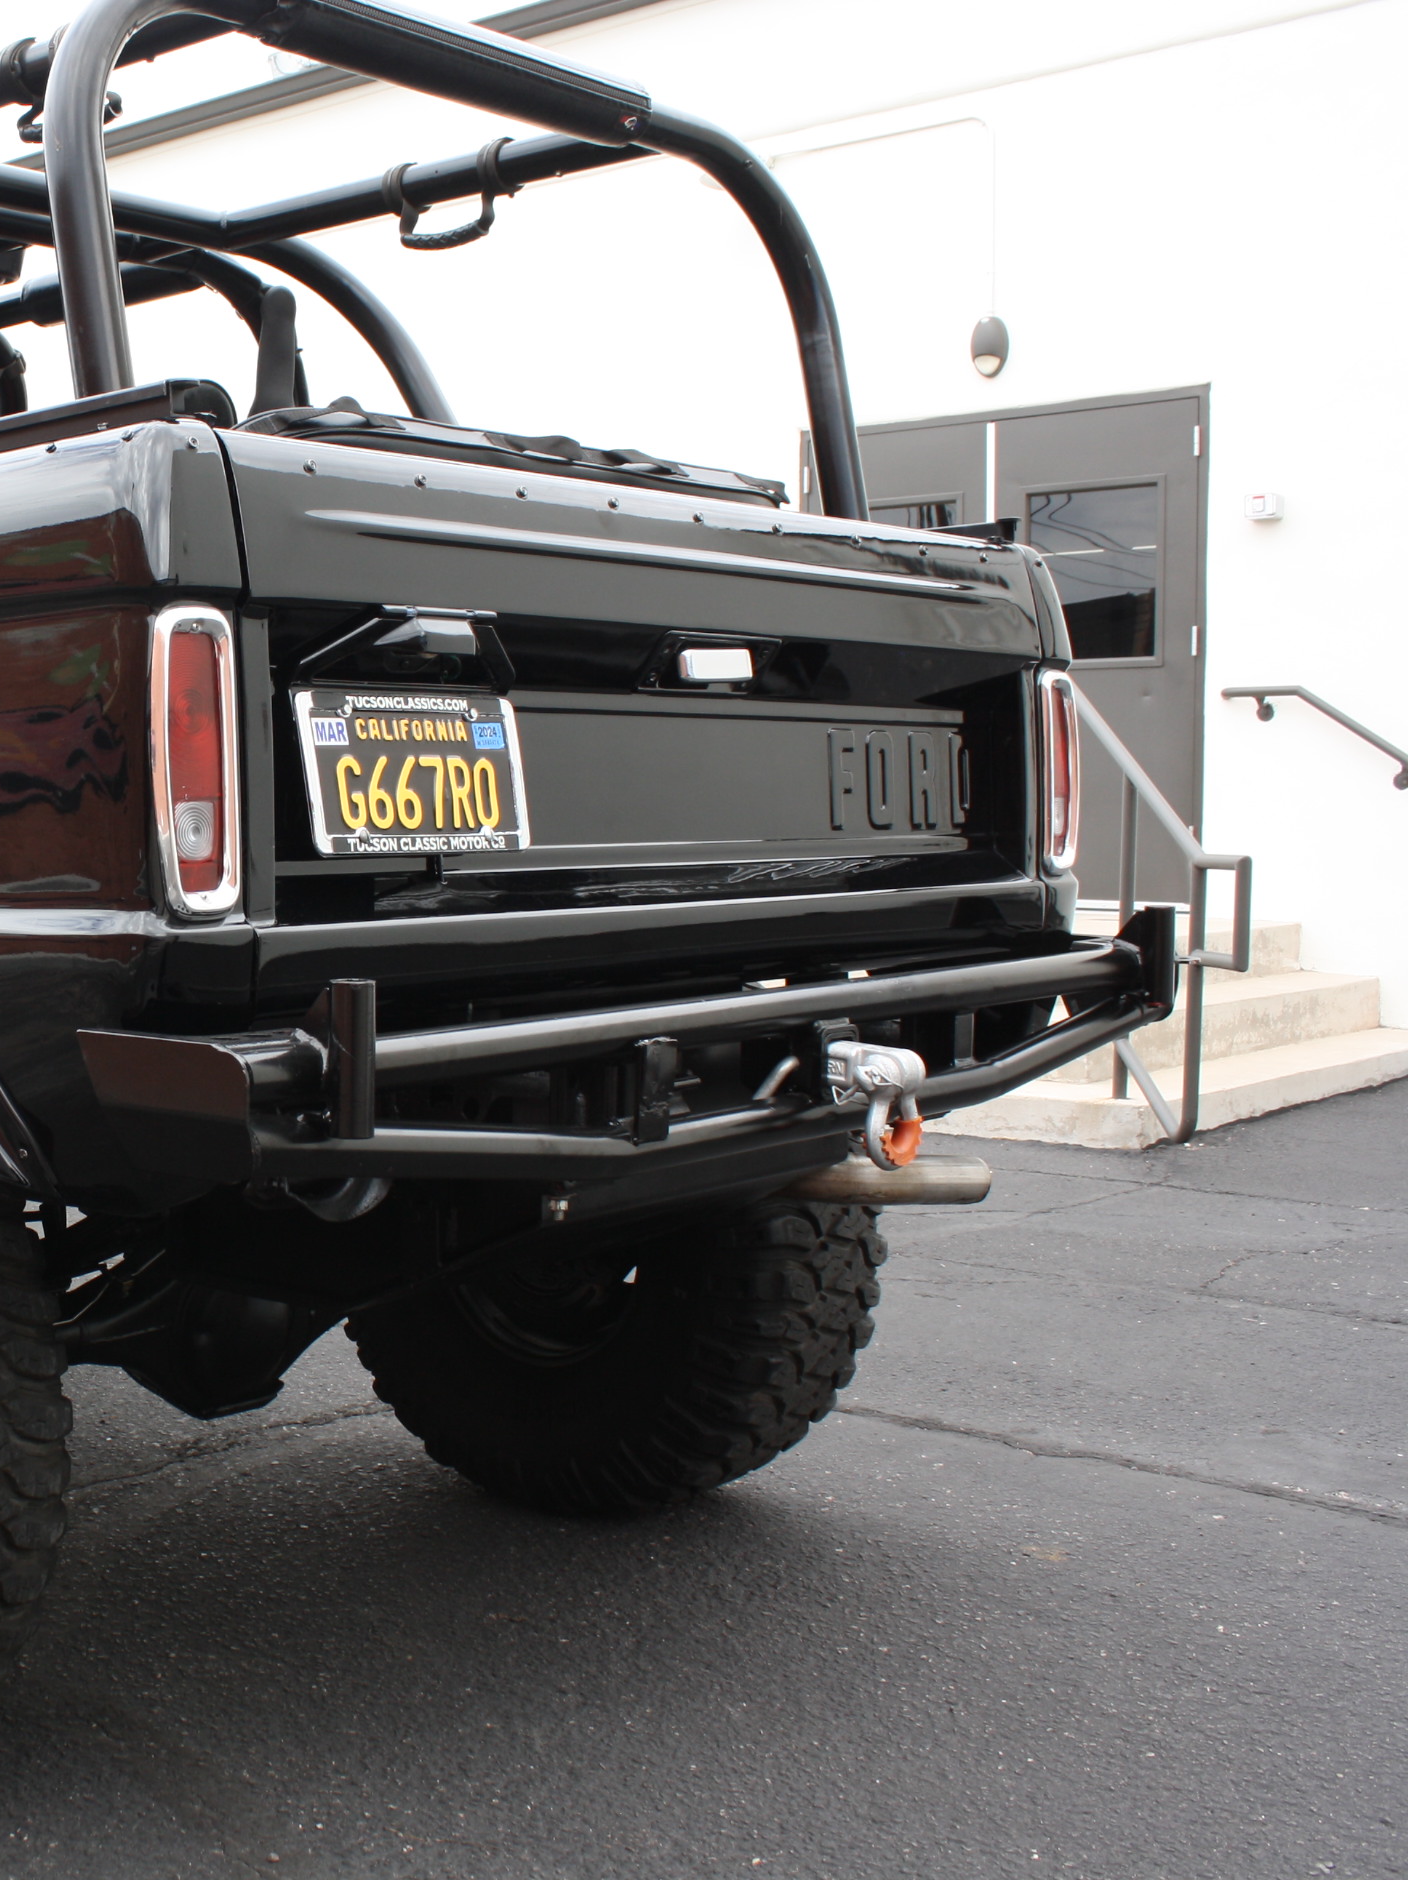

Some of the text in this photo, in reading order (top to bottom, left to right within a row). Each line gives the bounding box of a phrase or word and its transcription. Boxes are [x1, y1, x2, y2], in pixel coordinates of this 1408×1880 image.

[345, 695, 468, 712] TUCSONCLASSICS.COM
[314, 721, 348, 743] MAR
[354, 717, 468, 742] CALIFORNIA
[827, 727, 971, 831] FORD
[400, 837, 449, 851] CLASSIC
[449, 836, 491, 850] MOTOR
